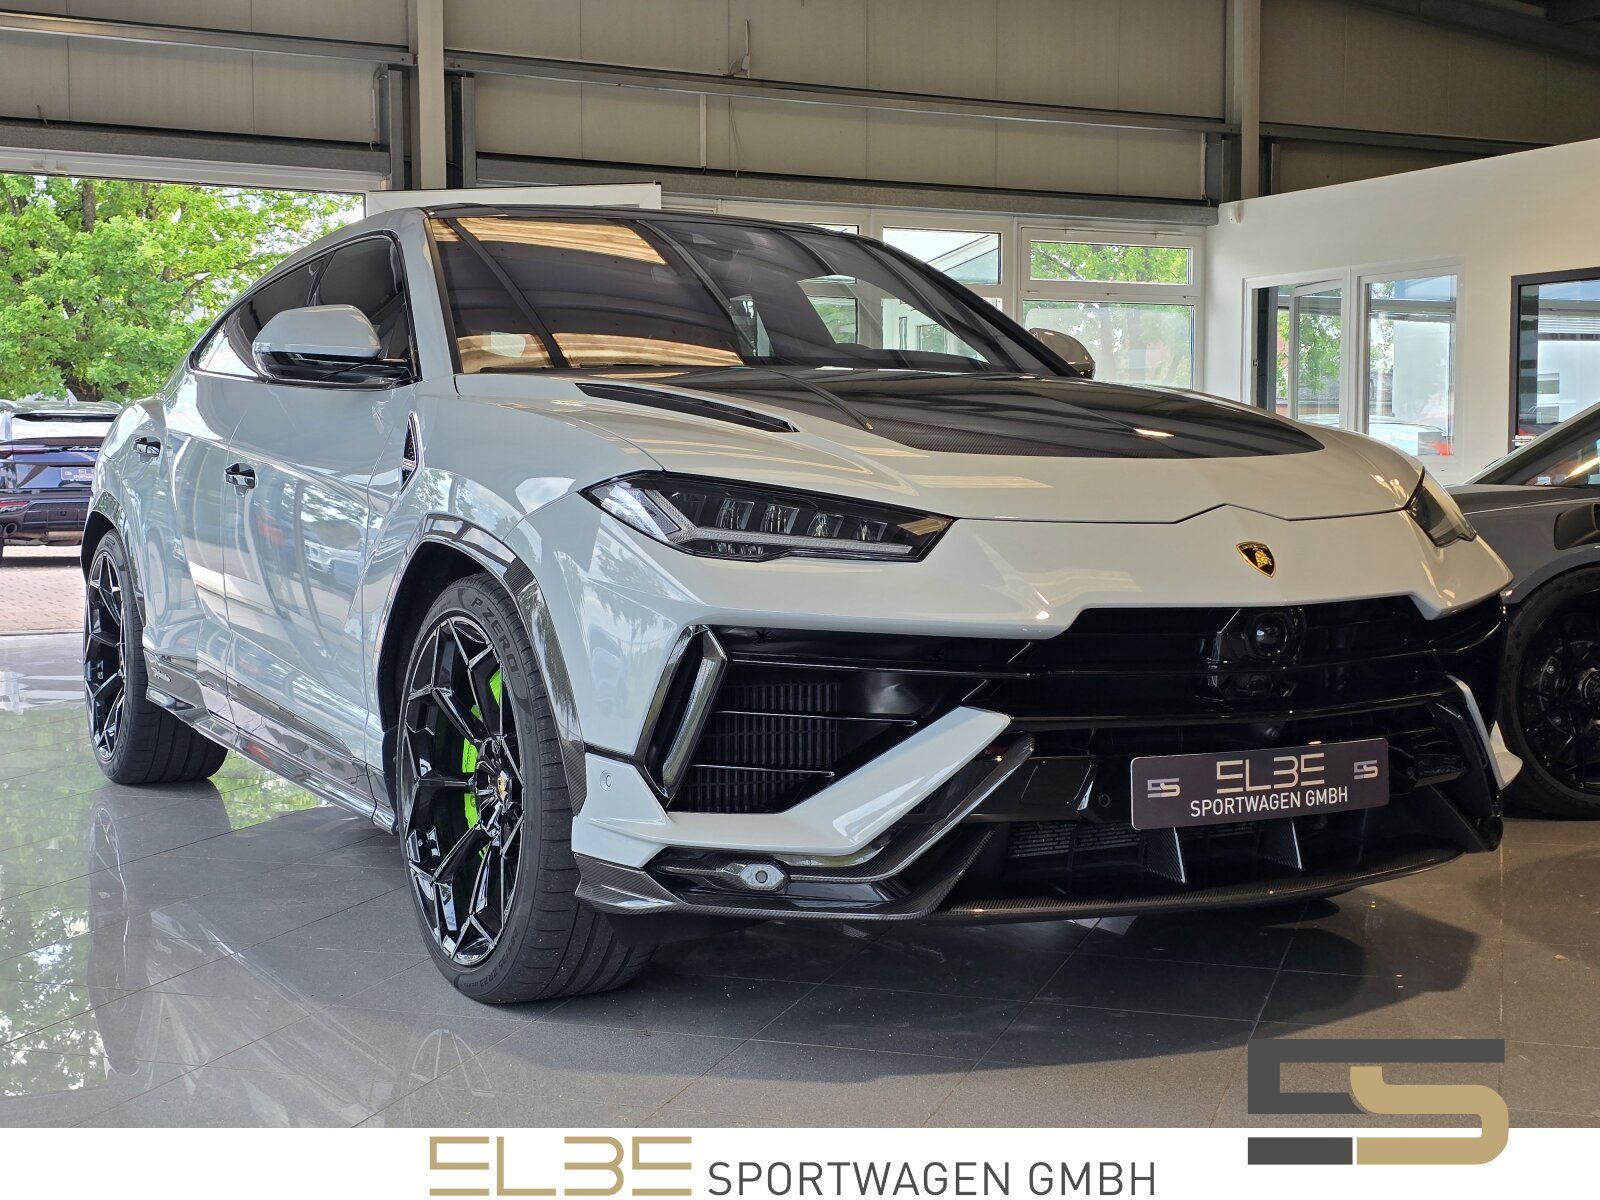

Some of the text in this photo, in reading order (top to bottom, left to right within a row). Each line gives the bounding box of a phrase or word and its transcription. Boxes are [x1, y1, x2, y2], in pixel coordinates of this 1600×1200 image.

[471, 597, 519, 673] P ZERO
[1216, 752, 1325, 794] ELBE
[1190, 786, 1348, 818] SPORTWAGEN GMBH
